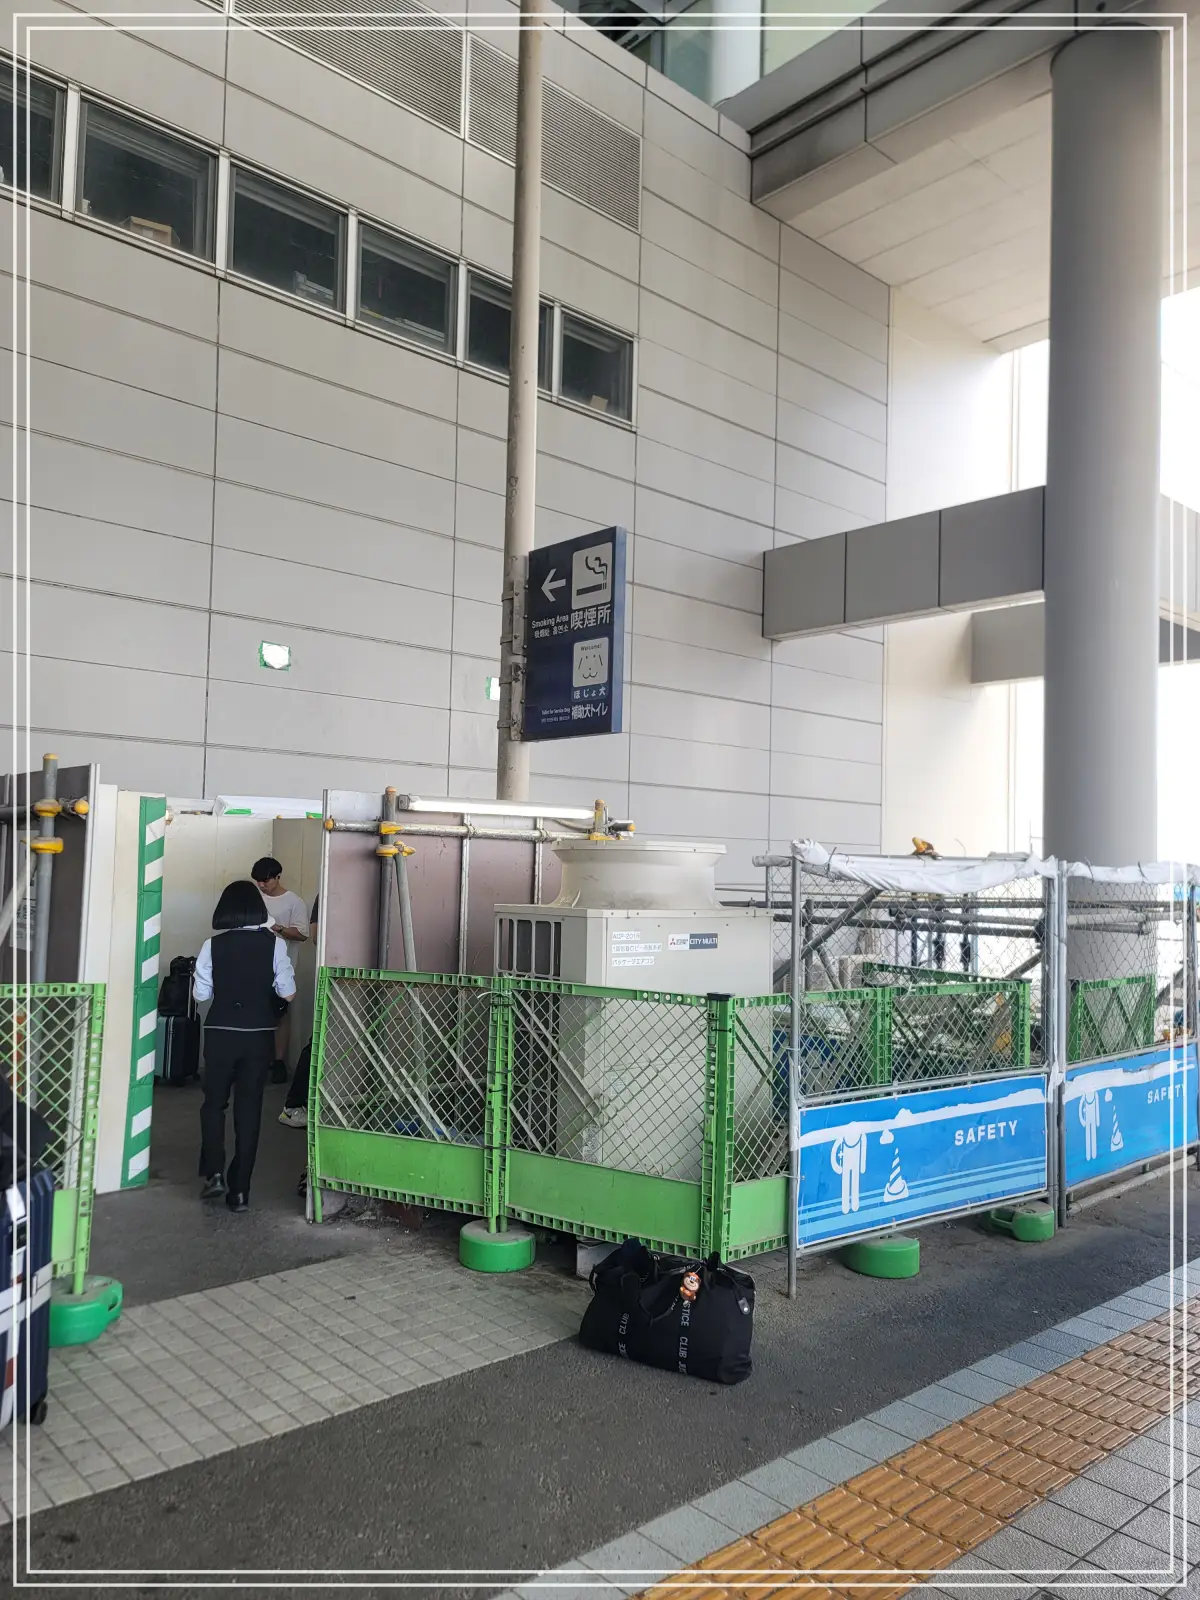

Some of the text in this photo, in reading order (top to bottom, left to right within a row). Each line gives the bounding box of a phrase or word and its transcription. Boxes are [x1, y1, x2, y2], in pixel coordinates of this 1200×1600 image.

[531, 614, 569, 629] Smoking Area
[570, 604, 611, 630] 喫煙所
[571, 702, 608, 720] 補助犬トイレ
[954, 1119, 1018, 1146] SAFETY
[618, 1312, 630, 1335] CLUB
[678, 1336, 689, 1359] CLUB
